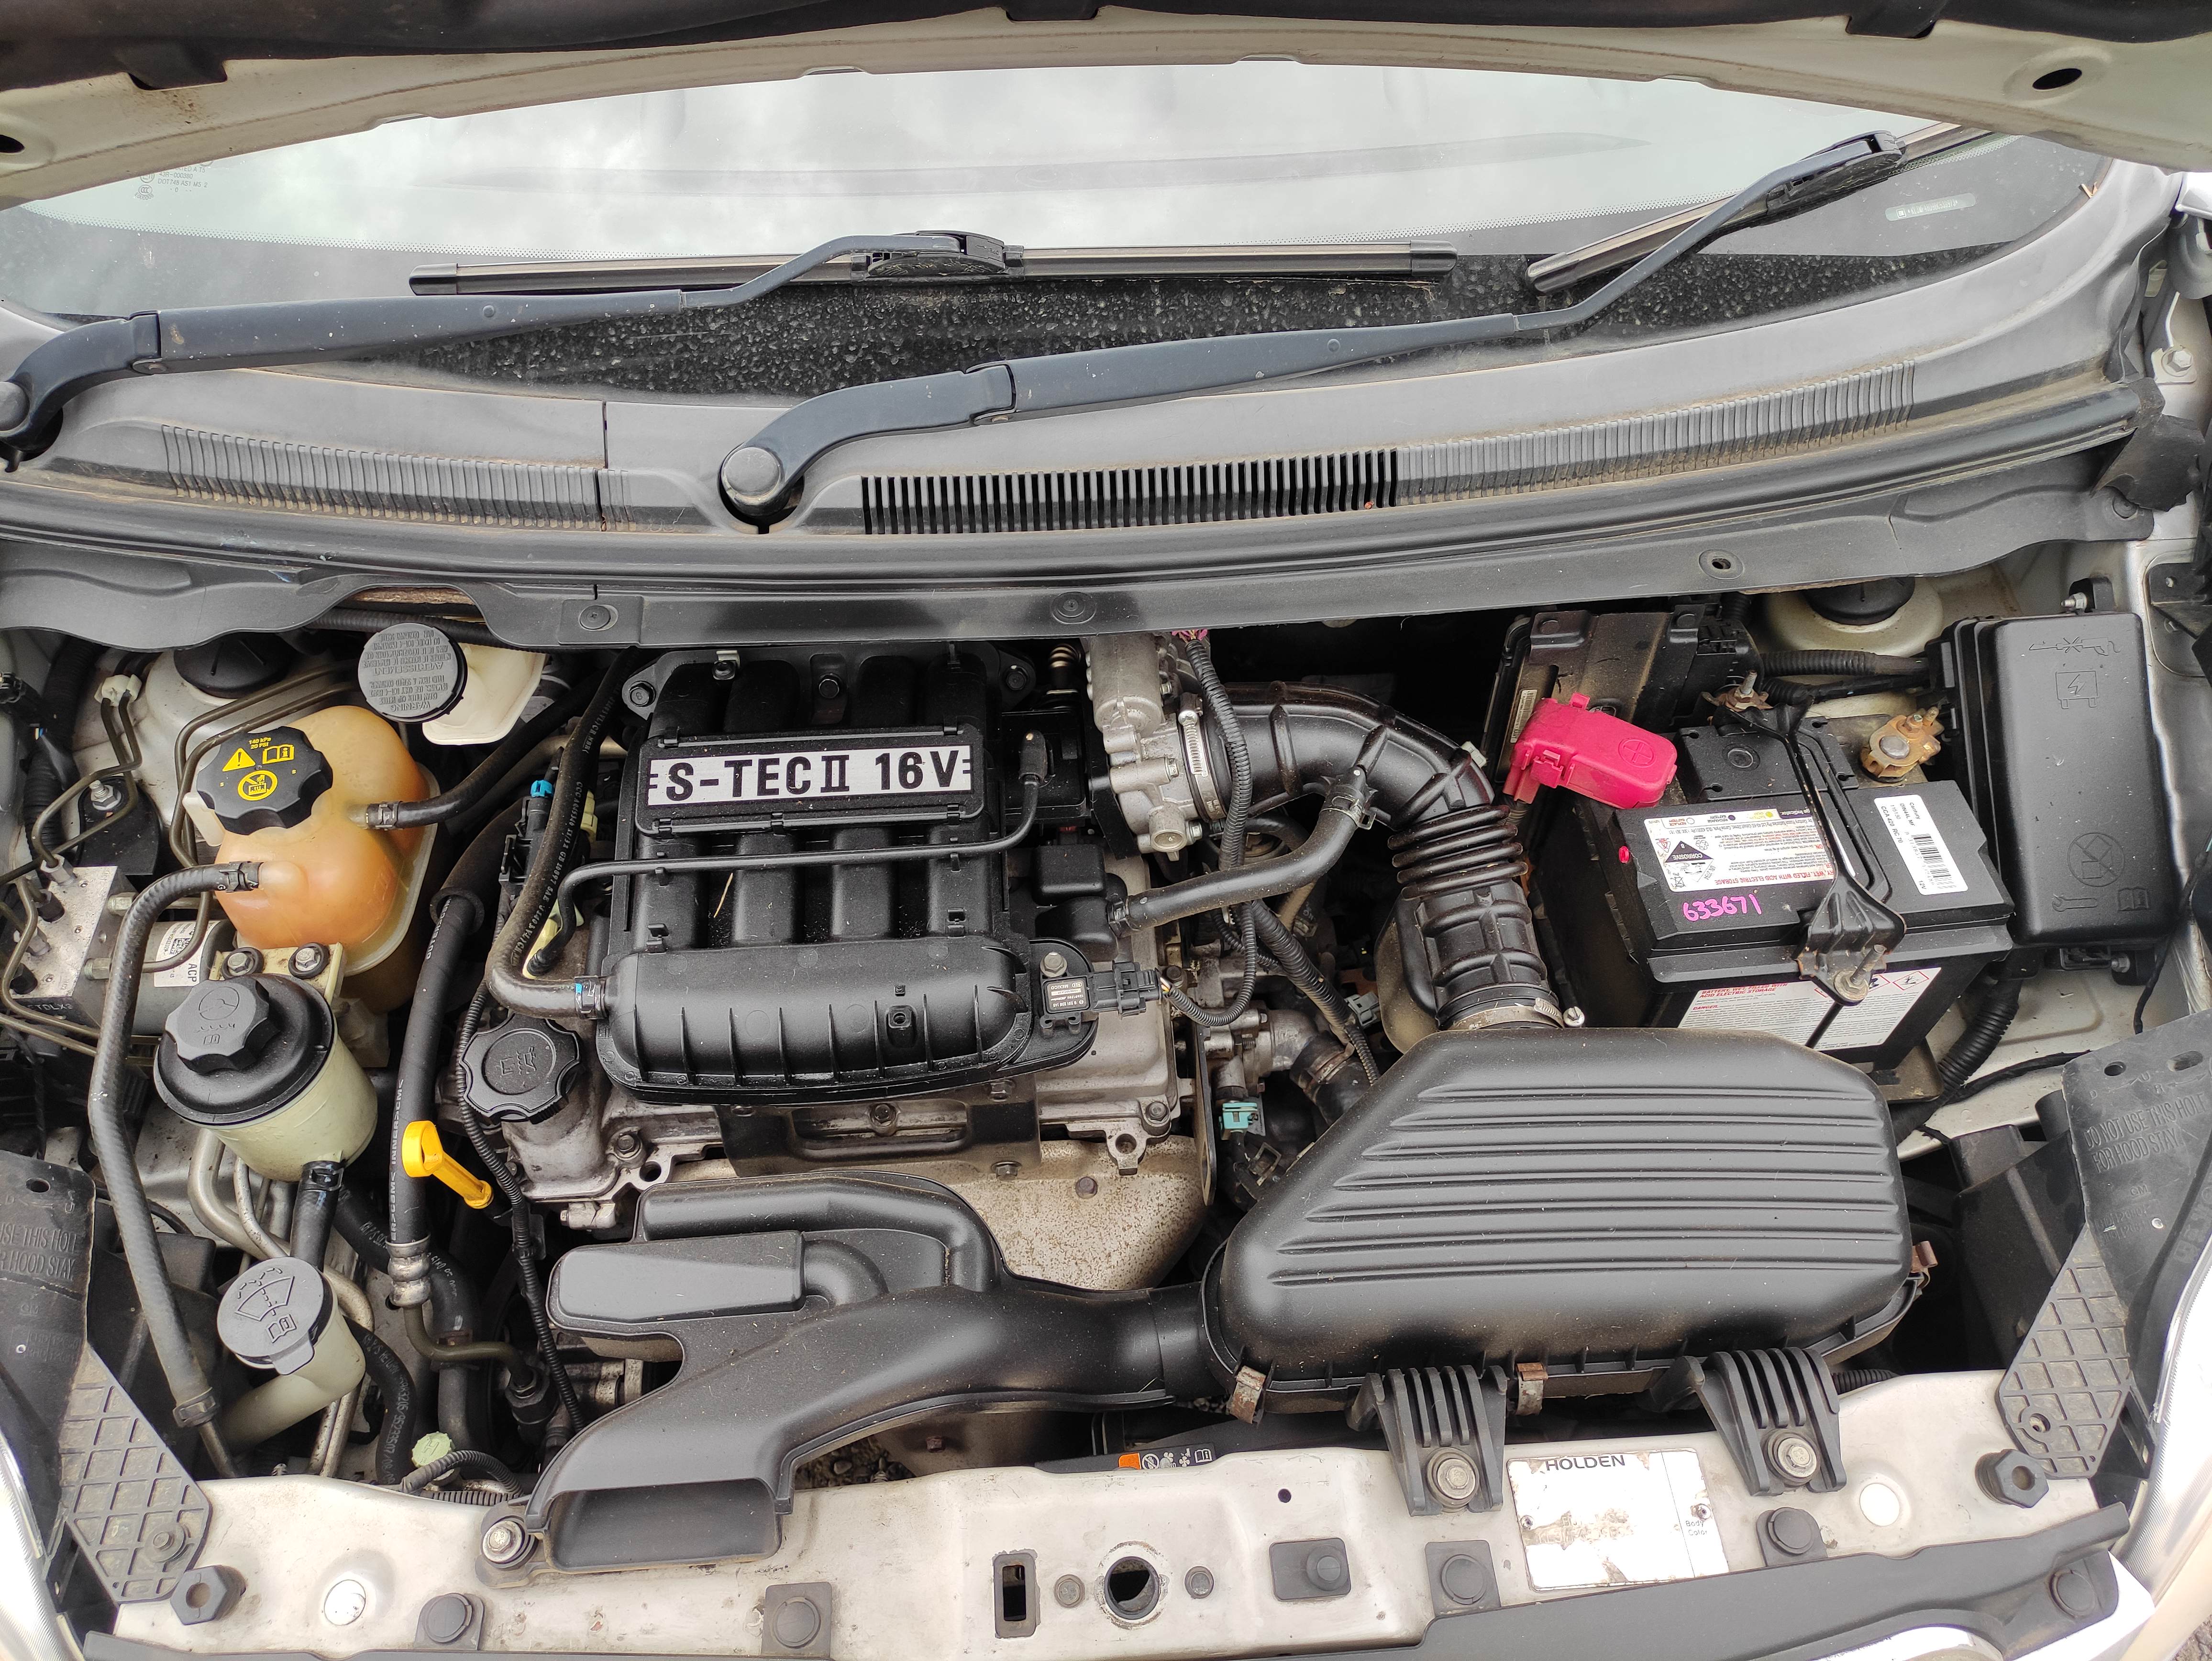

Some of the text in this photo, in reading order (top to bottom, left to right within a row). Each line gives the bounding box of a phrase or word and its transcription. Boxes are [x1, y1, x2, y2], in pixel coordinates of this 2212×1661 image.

[373, 662, 443, 675] AVERTISSEMENT
[391, 701, 430, 712] WARNING
[875, 750, 959, 790] 16V
[1881, 806, 1890, 817] CCA
[1900, 804, 1910, 819] DIN44L
[1910, 802, 1920, 819] Century
[1918, 880, 1926, 889] 12V
[188, 963, 198, 982] ACP
[2083, 1126, 2101, 1149] DO
[2100, 1118, 2124, 1143] NOT
[2123, 1110, 2149, 1134] USE
[2146, 1102, 2177, 1126] THIS
[2092, 1147, 2117, 1173] FOR
[2113, 1136, 2150, 1164] HOOD
[24, 1226, 48, 1248] THIS
[9, 1251, 44, 1273] HOOD
[1545, 1455, 1625, 1471] HOLDEN
